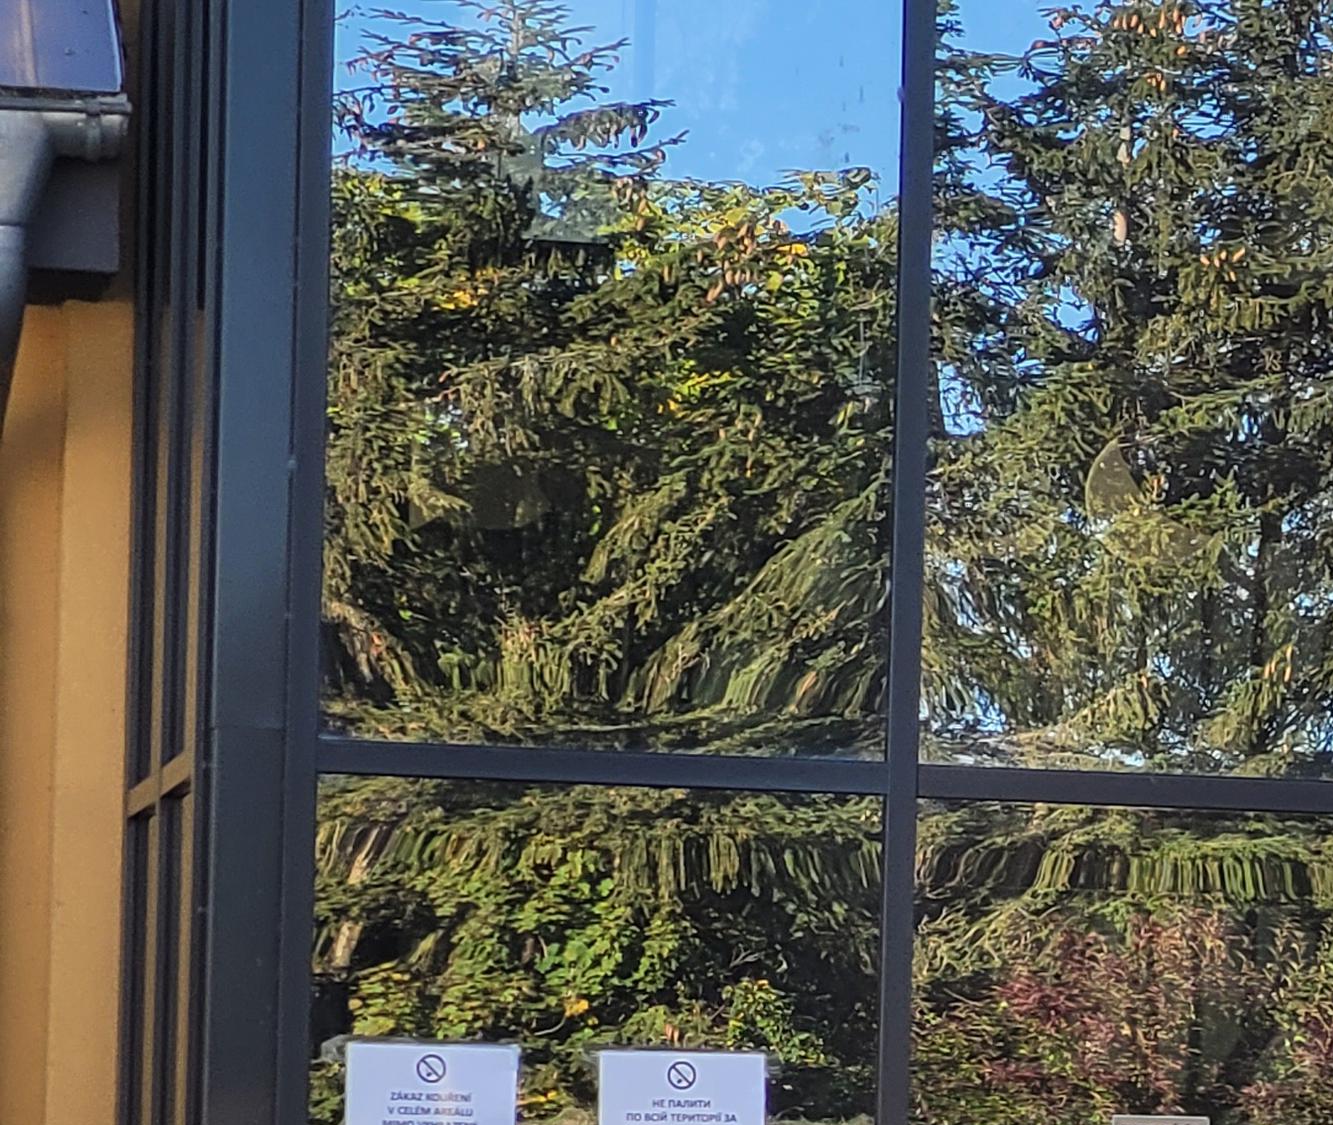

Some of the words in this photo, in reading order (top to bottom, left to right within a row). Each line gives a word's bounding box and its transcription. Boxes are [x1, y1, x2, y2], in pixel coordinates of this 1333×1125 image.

[390, 1091, 423, 1101] ZÁKAZ
[652, 1099, 667, 1108] НЕ
[668, 1099, 711, 1108] ПАЛИТИ
[387, 1106, 395, 1114] V
[397, 1105, 431, 1115] CELÉM
[626, 1112, 641, 1121] ПО
[724, 1114, 738, 1122] ЗА
